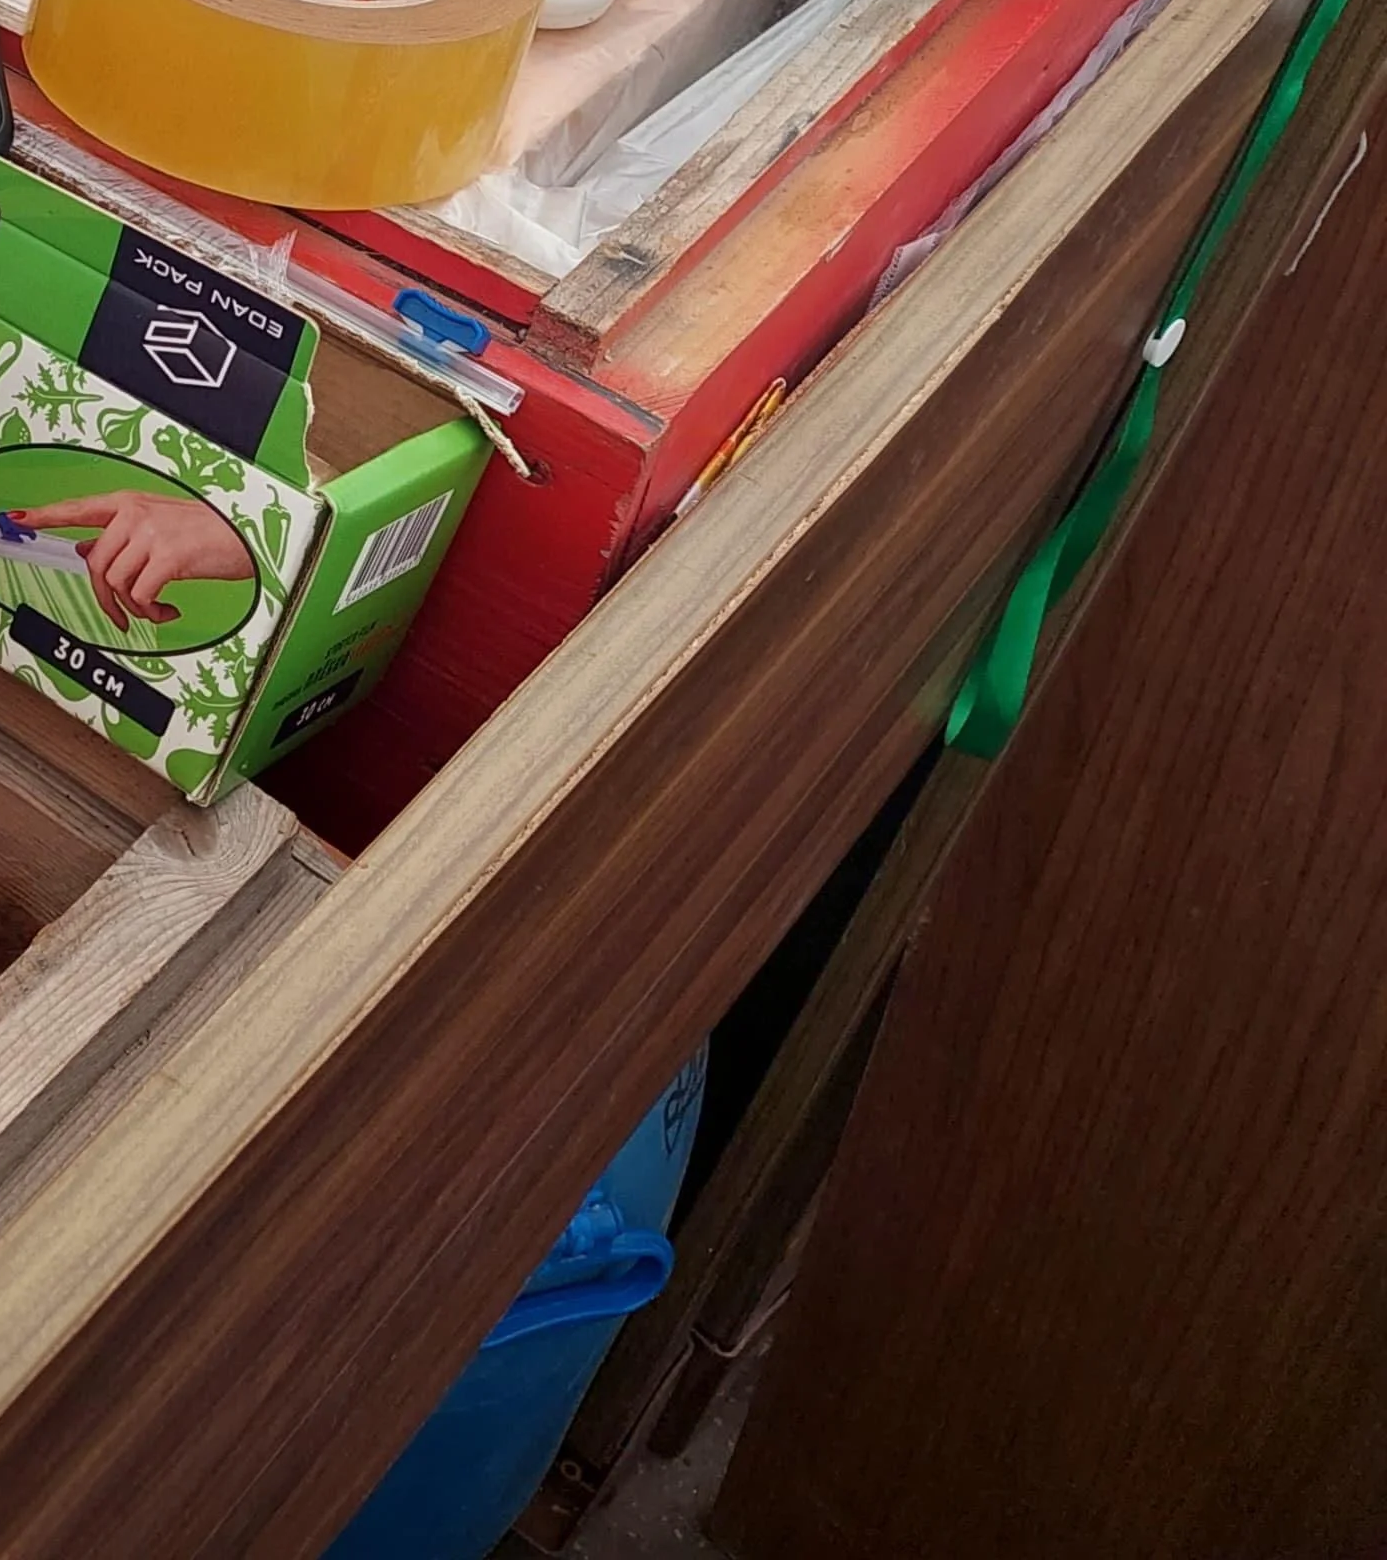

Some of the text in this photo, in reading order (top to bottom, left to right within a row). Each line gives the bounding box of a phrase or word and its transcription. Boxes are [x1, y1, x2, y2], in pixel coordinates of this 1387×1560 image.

[133, 247, 284, 339] EDAN PACK
[53, 636, 86, 670] 30
